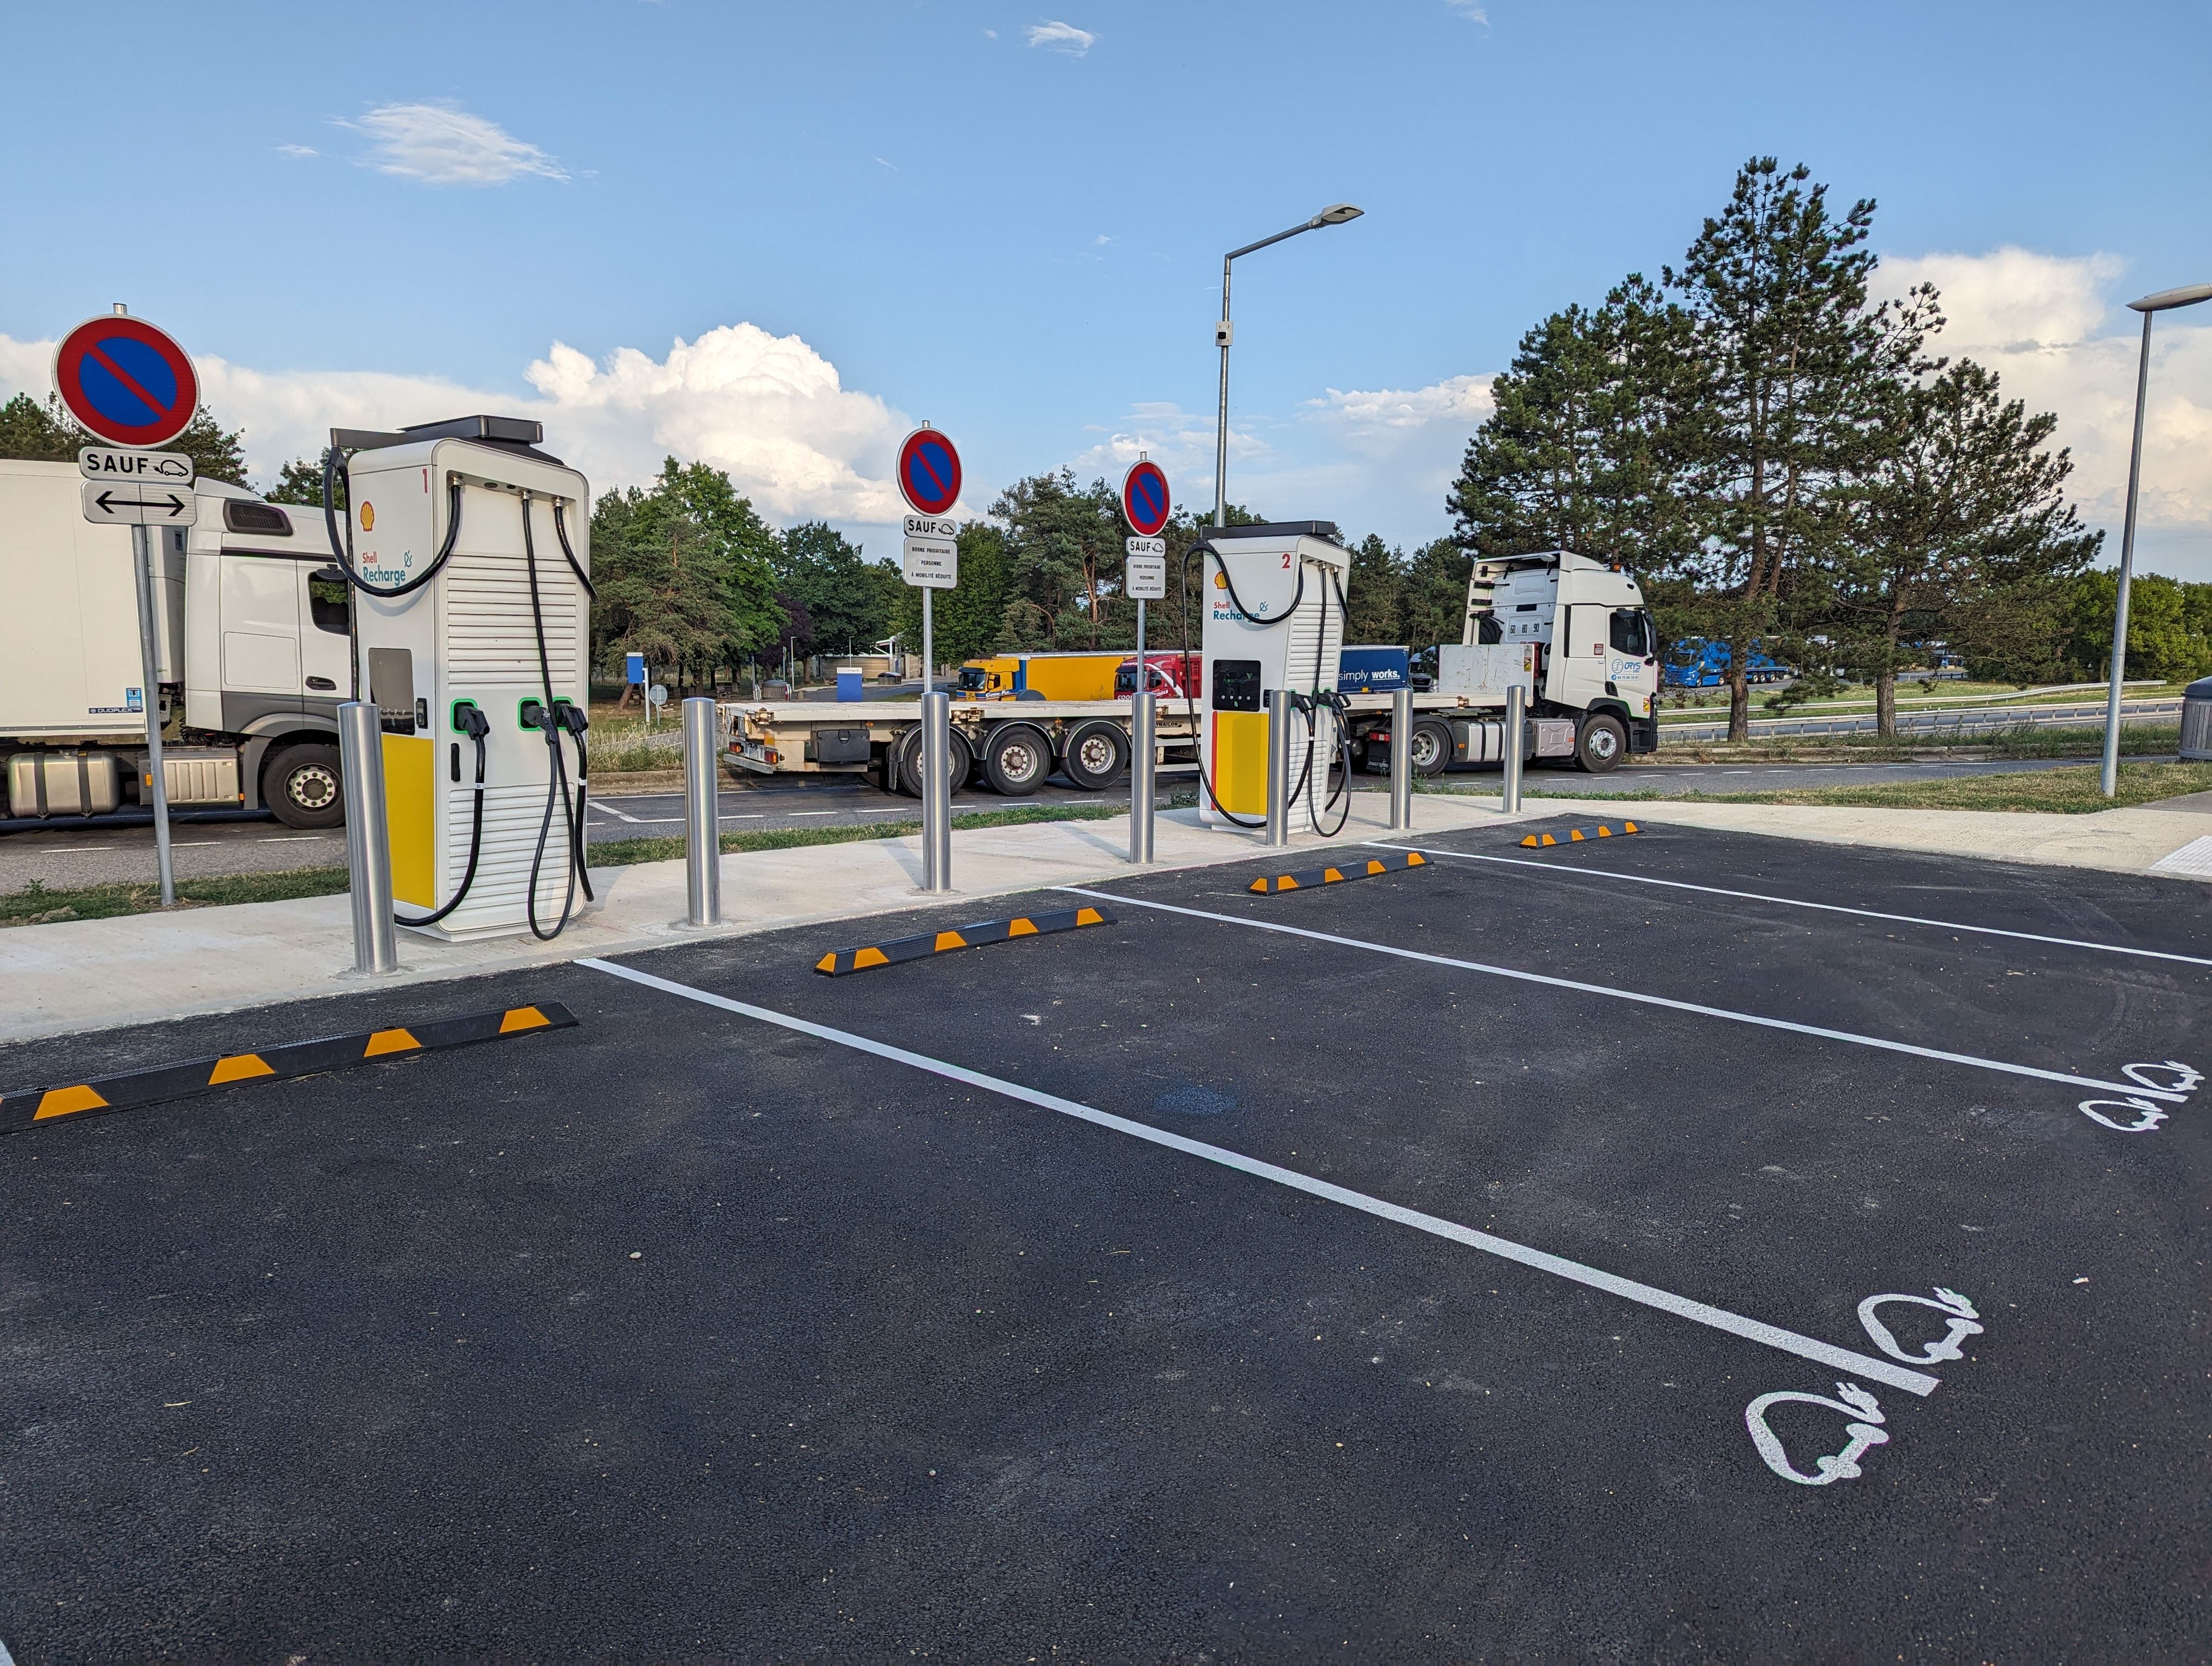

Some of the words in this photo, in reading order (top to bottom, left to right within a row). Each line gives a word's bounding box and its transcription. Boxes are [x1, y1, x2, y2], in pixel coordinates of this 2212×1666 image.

[87, 453, 149, 475] SAUF
[422, 468, 428, 494] 1
[908, 519, 936, 534] SAUF
[1130, 541, 1151, 552] SAUF
[362, 551, 377, 564] Shell
[1281, 553, 1290, 569] 2
[363, 564, 406, 587] Recharge
[1510, 625, 1516, 634] 60
[1522, 624, 1528, 633] 80
[1533, 623, 1540, 632] 90
[1624, 662, 1641, 670] ORYS
[1339, 669, 1369, 683] simply
[1371, 669, 1400, 679] works.
